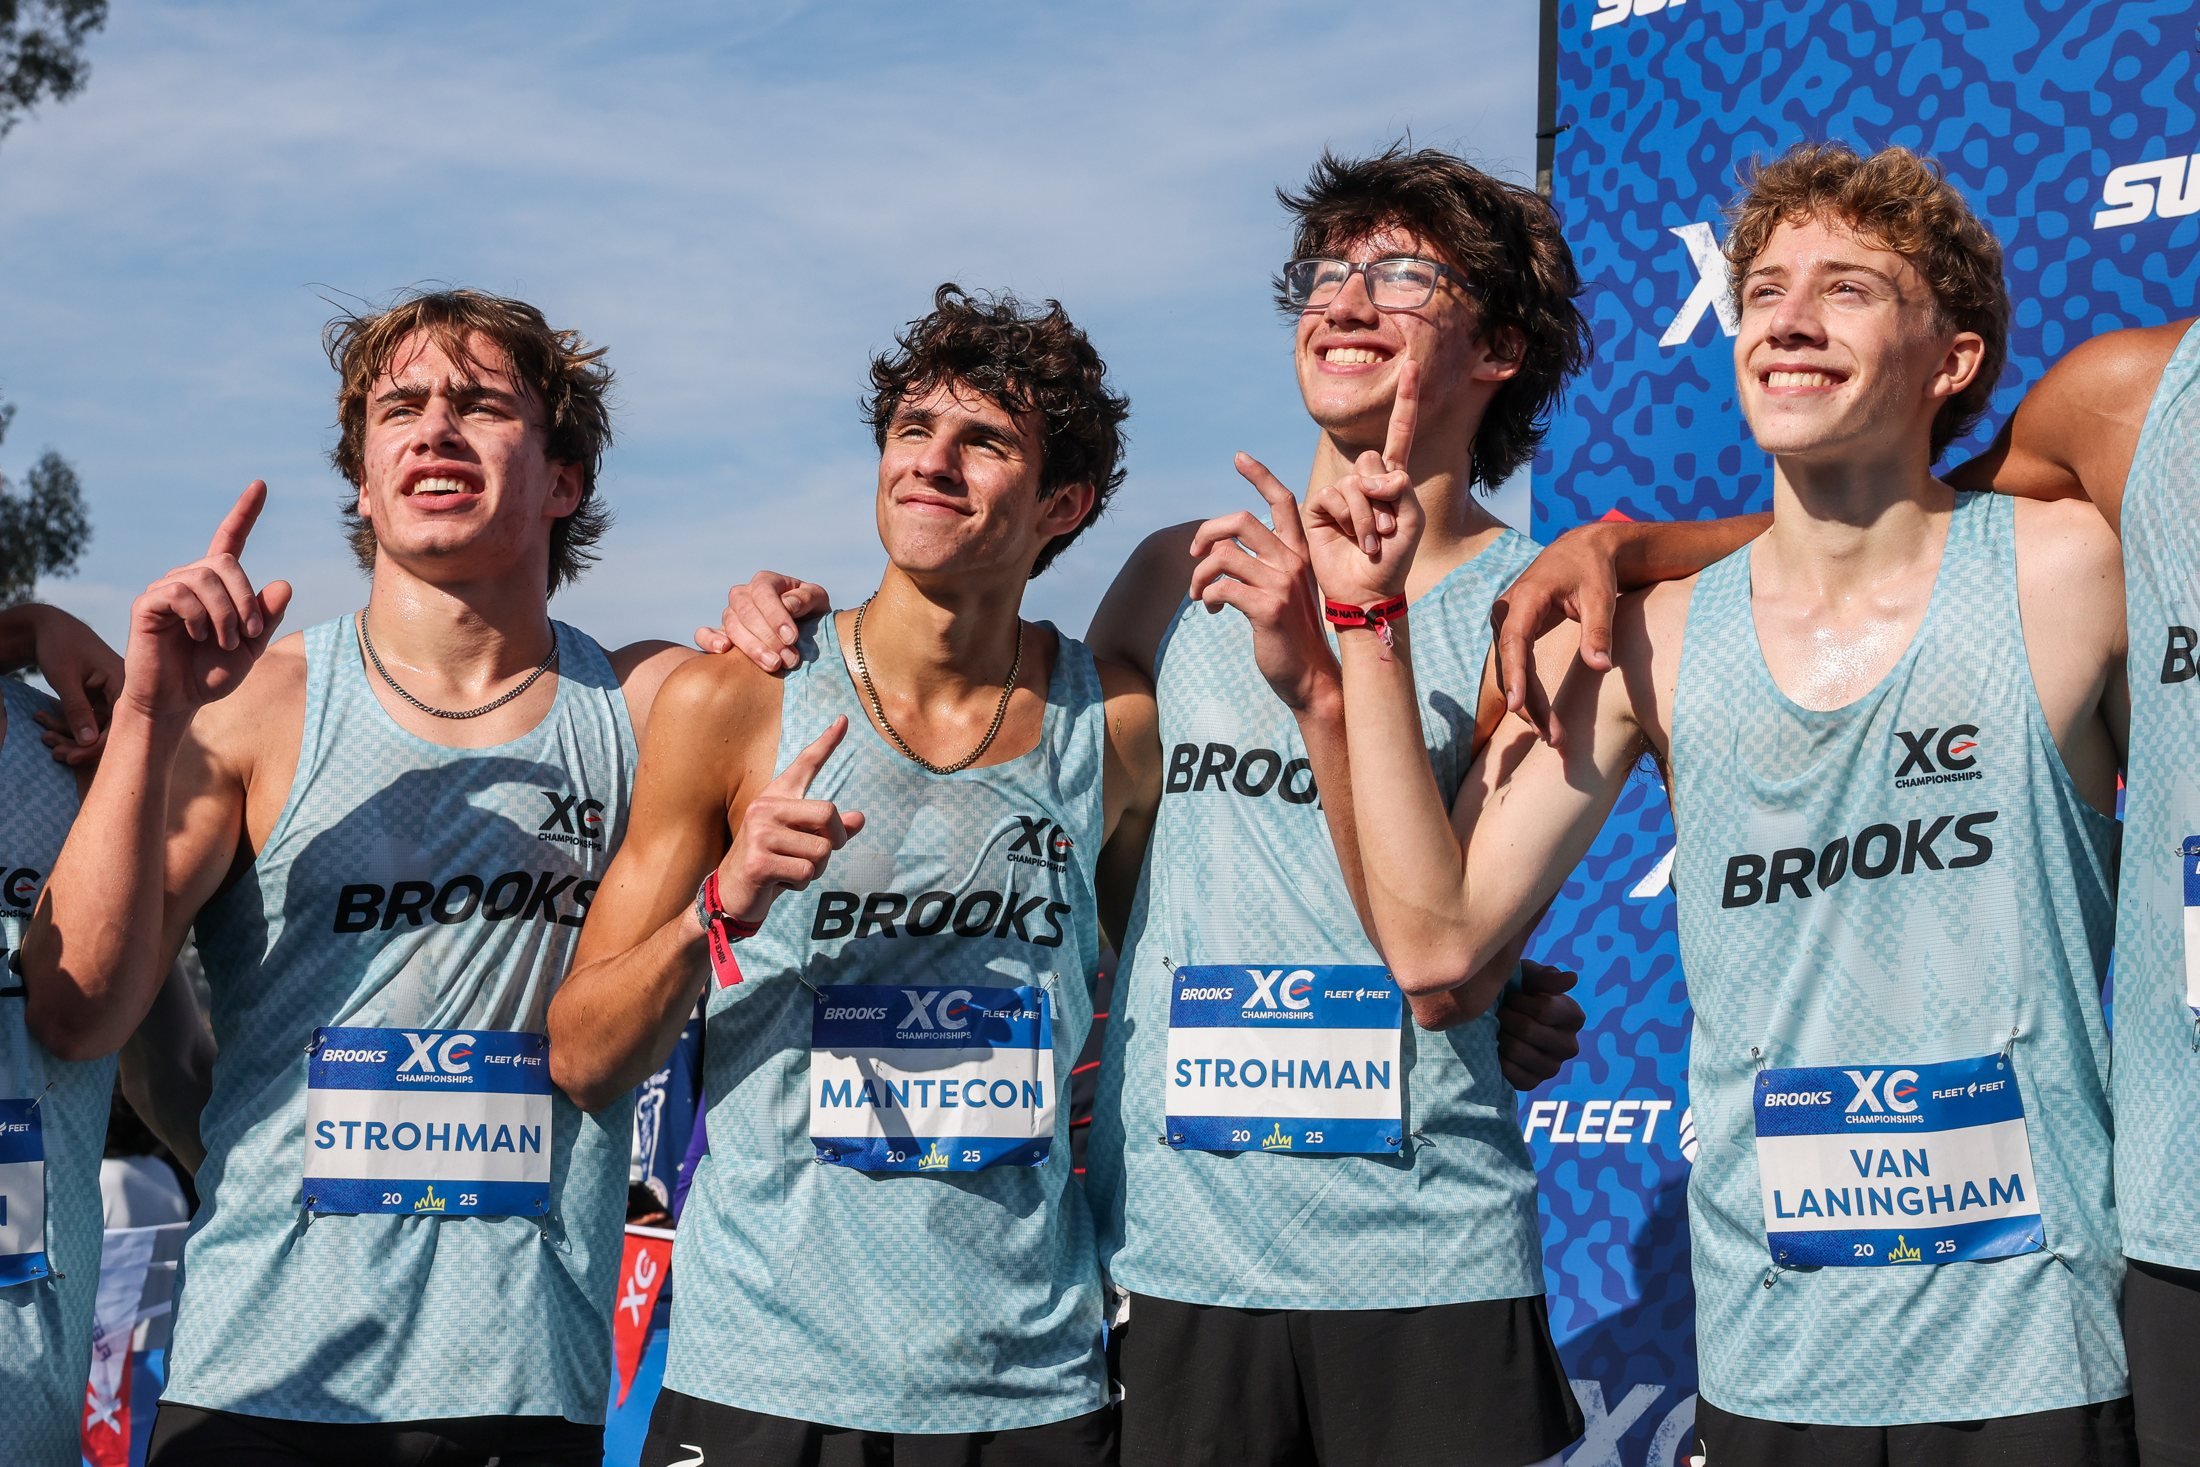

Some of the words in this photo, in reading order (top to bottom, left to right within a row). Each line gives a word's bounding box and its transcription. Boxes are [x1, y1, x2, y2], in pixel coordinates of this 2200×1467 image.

[1893, 724, 1980, 778] XC
[1165, 742, 1323, 810] BROO
[1895, 771, 1983, 789] CHAMPIONSHIPS
[538, 791, 605, 839] XC
[1007, 815, 1074, 863] XC
[1721, 811, 2000, 910] BROOKS
[0, 867, 41, 909] C
[333, 871, 600, 933] BROOKS
[811, 890, 1071, 948] BROOKS
[1180, 987, 1234, 1000] BROOKS
[1242, 969, 1316, 1010] XC
[1324, 990, 1354, 999] FLEET
[1366, 990, 1391, 999] FEET
[824, 1007, 888, 1020] BROOKS
[896, 989, 973, 1030] XC
[982, 1009, 1011, 1019] FLEET
[1022, 1010, 1039, 1020] FEET
[1241, 1011, 1314, 1020] CHAMPIONSHIPS
[896, 1031, 972, 1040] CHAMPIONSHIPS
[321, 1049, 388, 1063] BROOKS
[396, 1033, 478, 1074] XC
[484, 1055, 511, 1064] FLEET
[522, 1057, 542, 1066] FEET
[395, 1074, 474, 1084] CHAMPIONSHIPS
[1174, 1058, 1390, 1089] STROHMAN
[819, 1079, 1044, 1109] MANTECON
[1764, 1091, 1832, 1107] BROOKS
[1843, 1070, 1920, 1113] XC
[1932, 1087, 1965, 1099] FLEET
[1979, 1081, 2006, 1093] FEET
[8, 1123, 30, 1133] FEET
[1523, 1100, 1672, 1144] FLEET
[1845, 1115, 1924, 1124] CHAMPIONSHIPS
[314, 1120, 541, 1154] STROHMAN
[1231, 1130, 1250, 1142] 20
[1305, 1131, 1324, 1143] 25
[886, 1150, 906, 1163] 20
[962, 1150, 981, 1163] 25
[1849, 1148, 1930, 1178] VAN
[382, 1193, 402, 1206] 20
[459, 1193, 478, 1206] 25
[1773, 1173, 2026, 1219] LANINGHAM
[1853, 1244, 1875, 1257] 20
[1935, 1240, 1956, 1254] 25
[619, 1247, 657, 1328] XC
